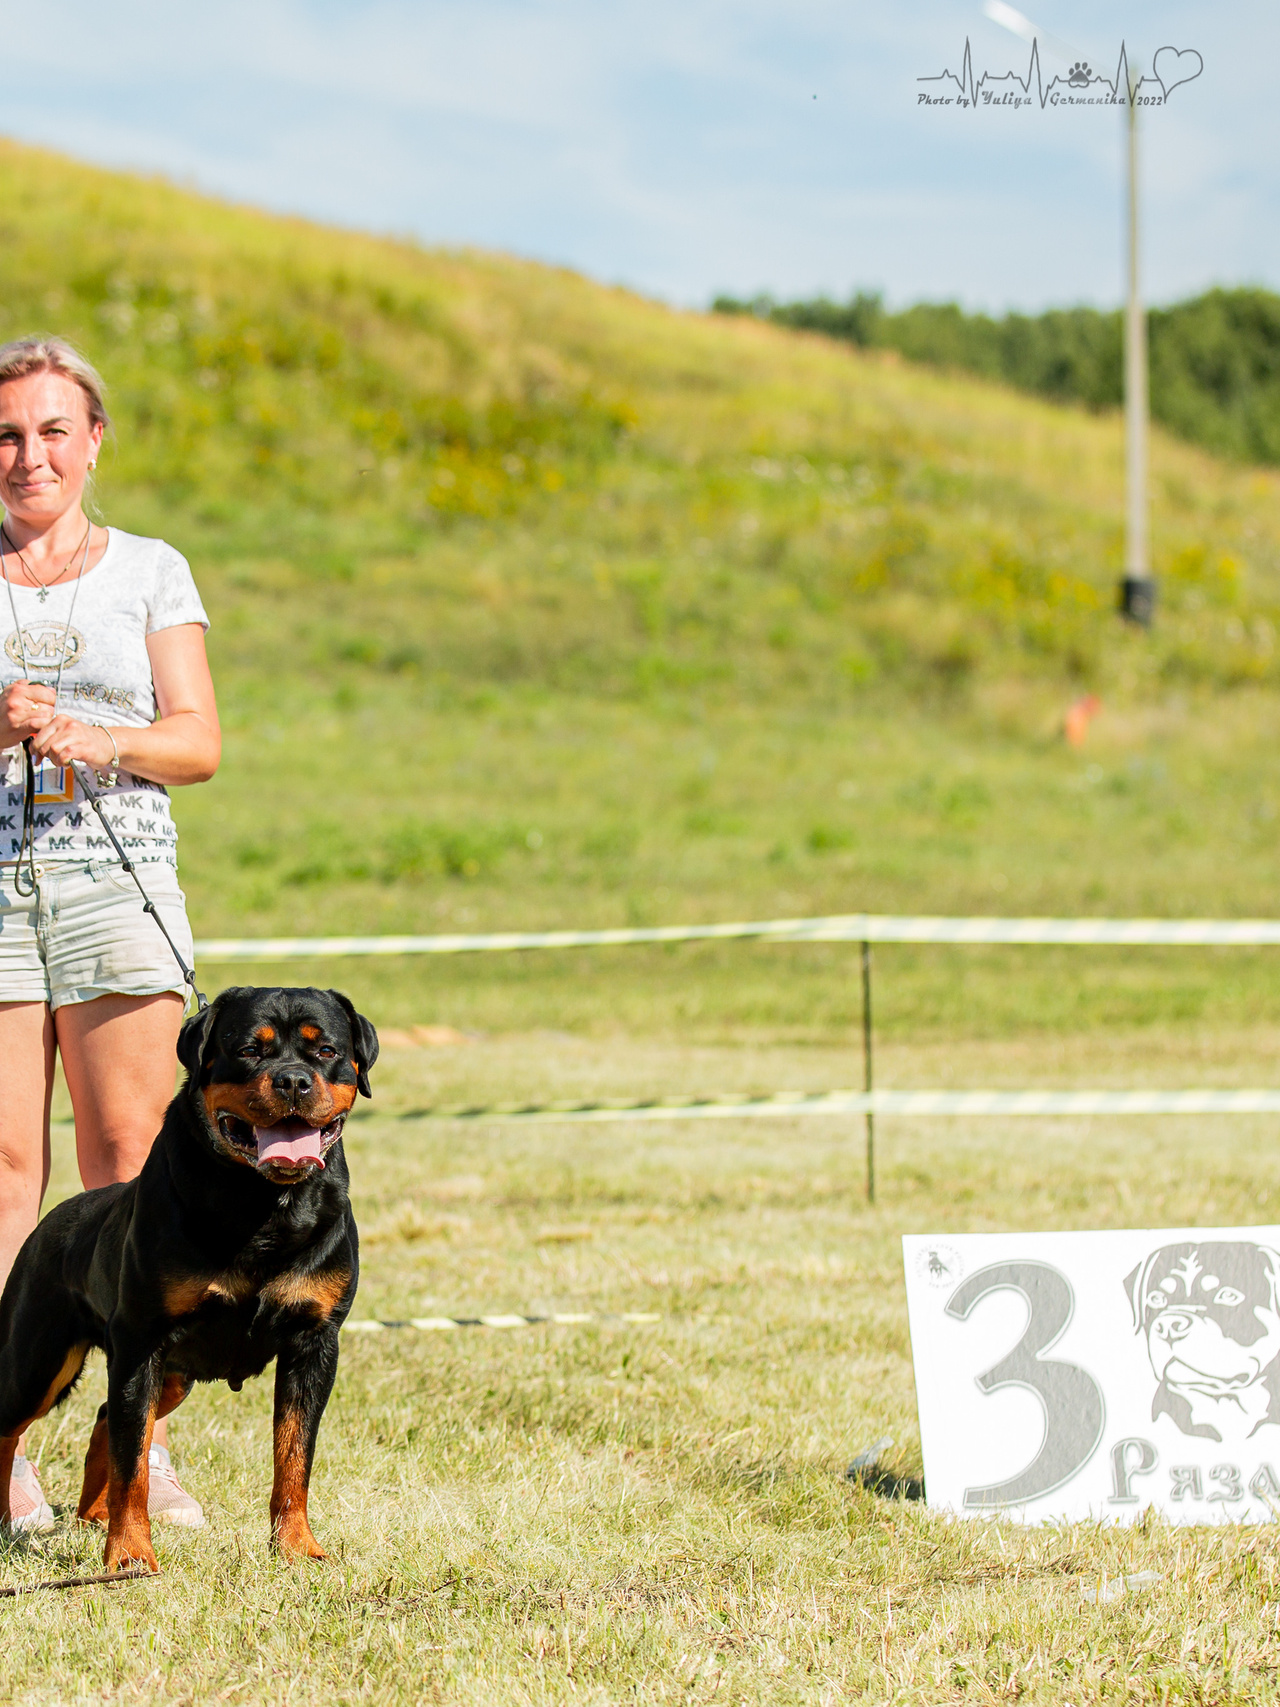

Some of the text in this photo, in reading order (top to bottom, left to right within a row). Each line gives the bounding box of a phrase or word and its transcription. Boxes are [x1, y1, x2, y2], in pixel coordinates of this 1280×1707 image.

[120, 795, 144, 810] MK
[64, 811, 92, 828] MK
[48, 835, 76, 851] MK
[86, 835, 112, 850] MK
[944, 1258, 1107, 1509] 3
